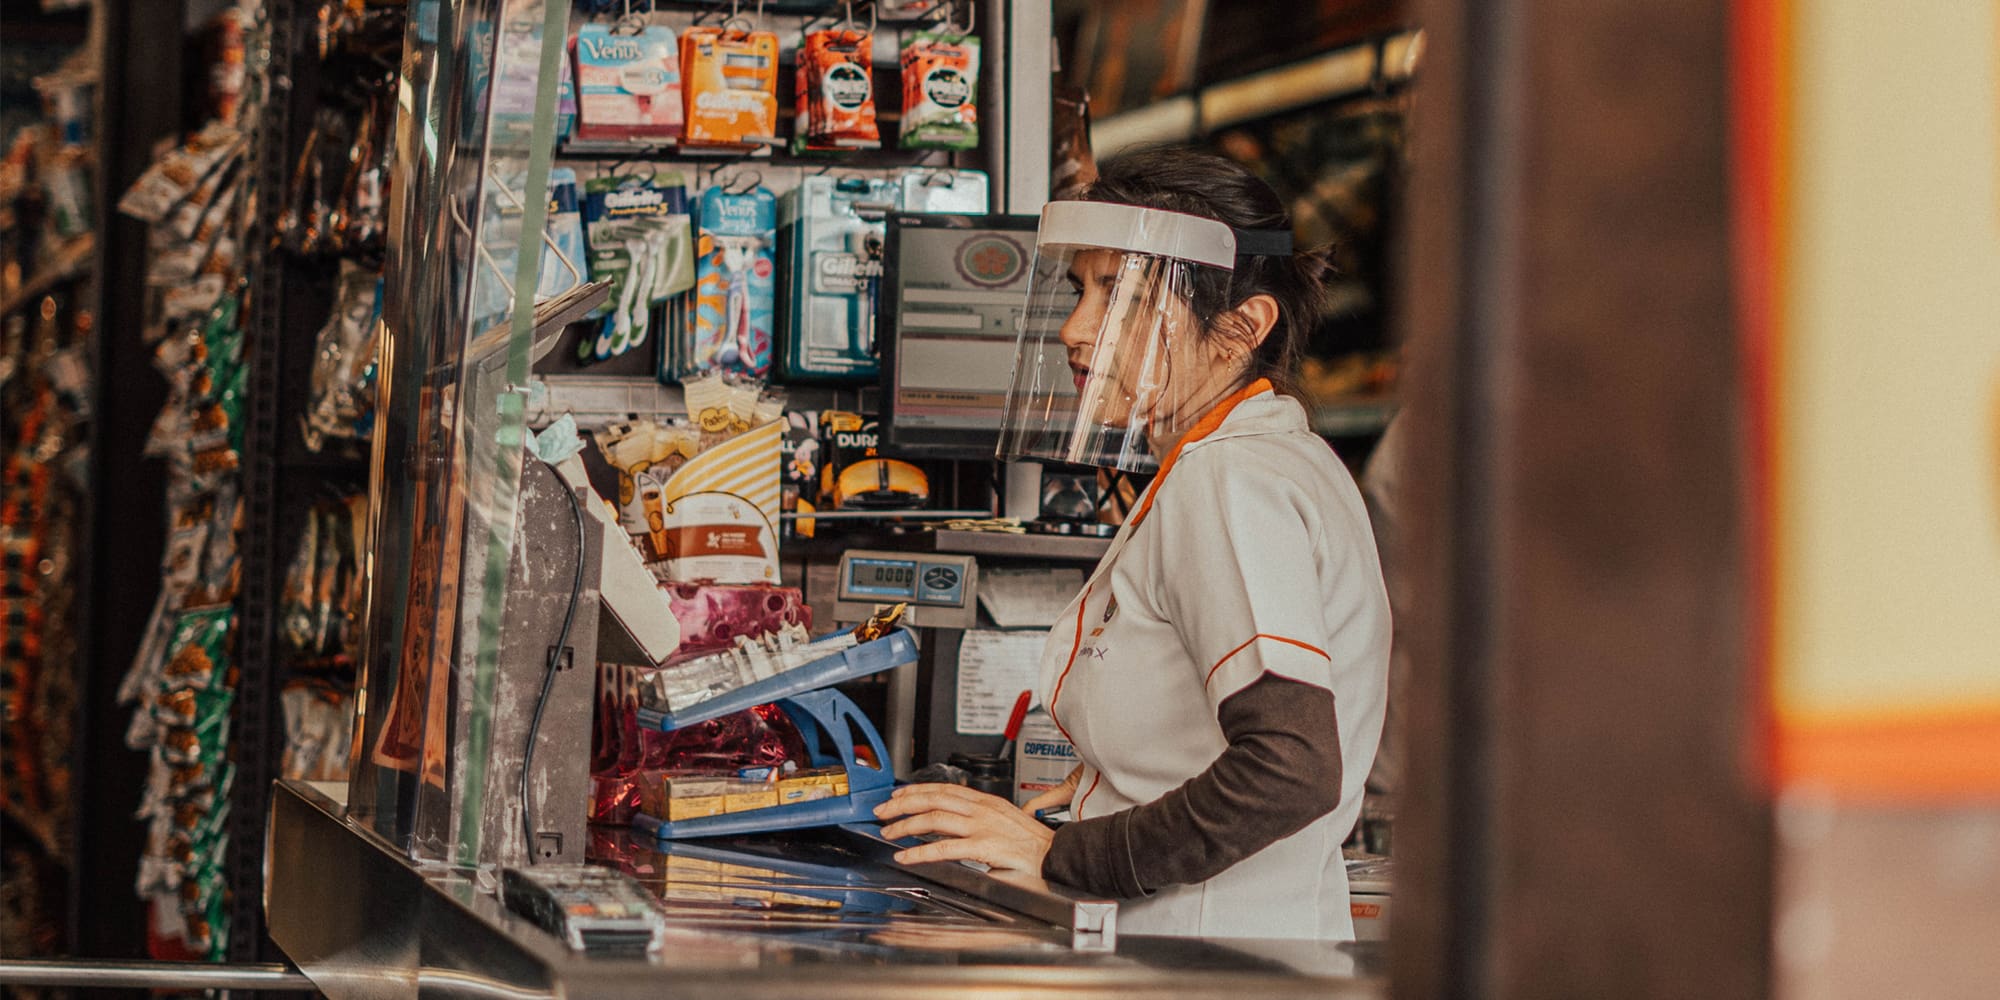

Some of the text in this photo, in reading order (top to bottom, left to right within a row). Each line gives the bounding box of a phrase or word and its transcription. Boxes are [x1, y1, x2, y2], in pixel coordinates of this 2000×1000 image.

[582, 37, 643, 60] Venus
[715, 197, 757, 216] Venus
[1023, 741, 1078, 758] COPERALC
